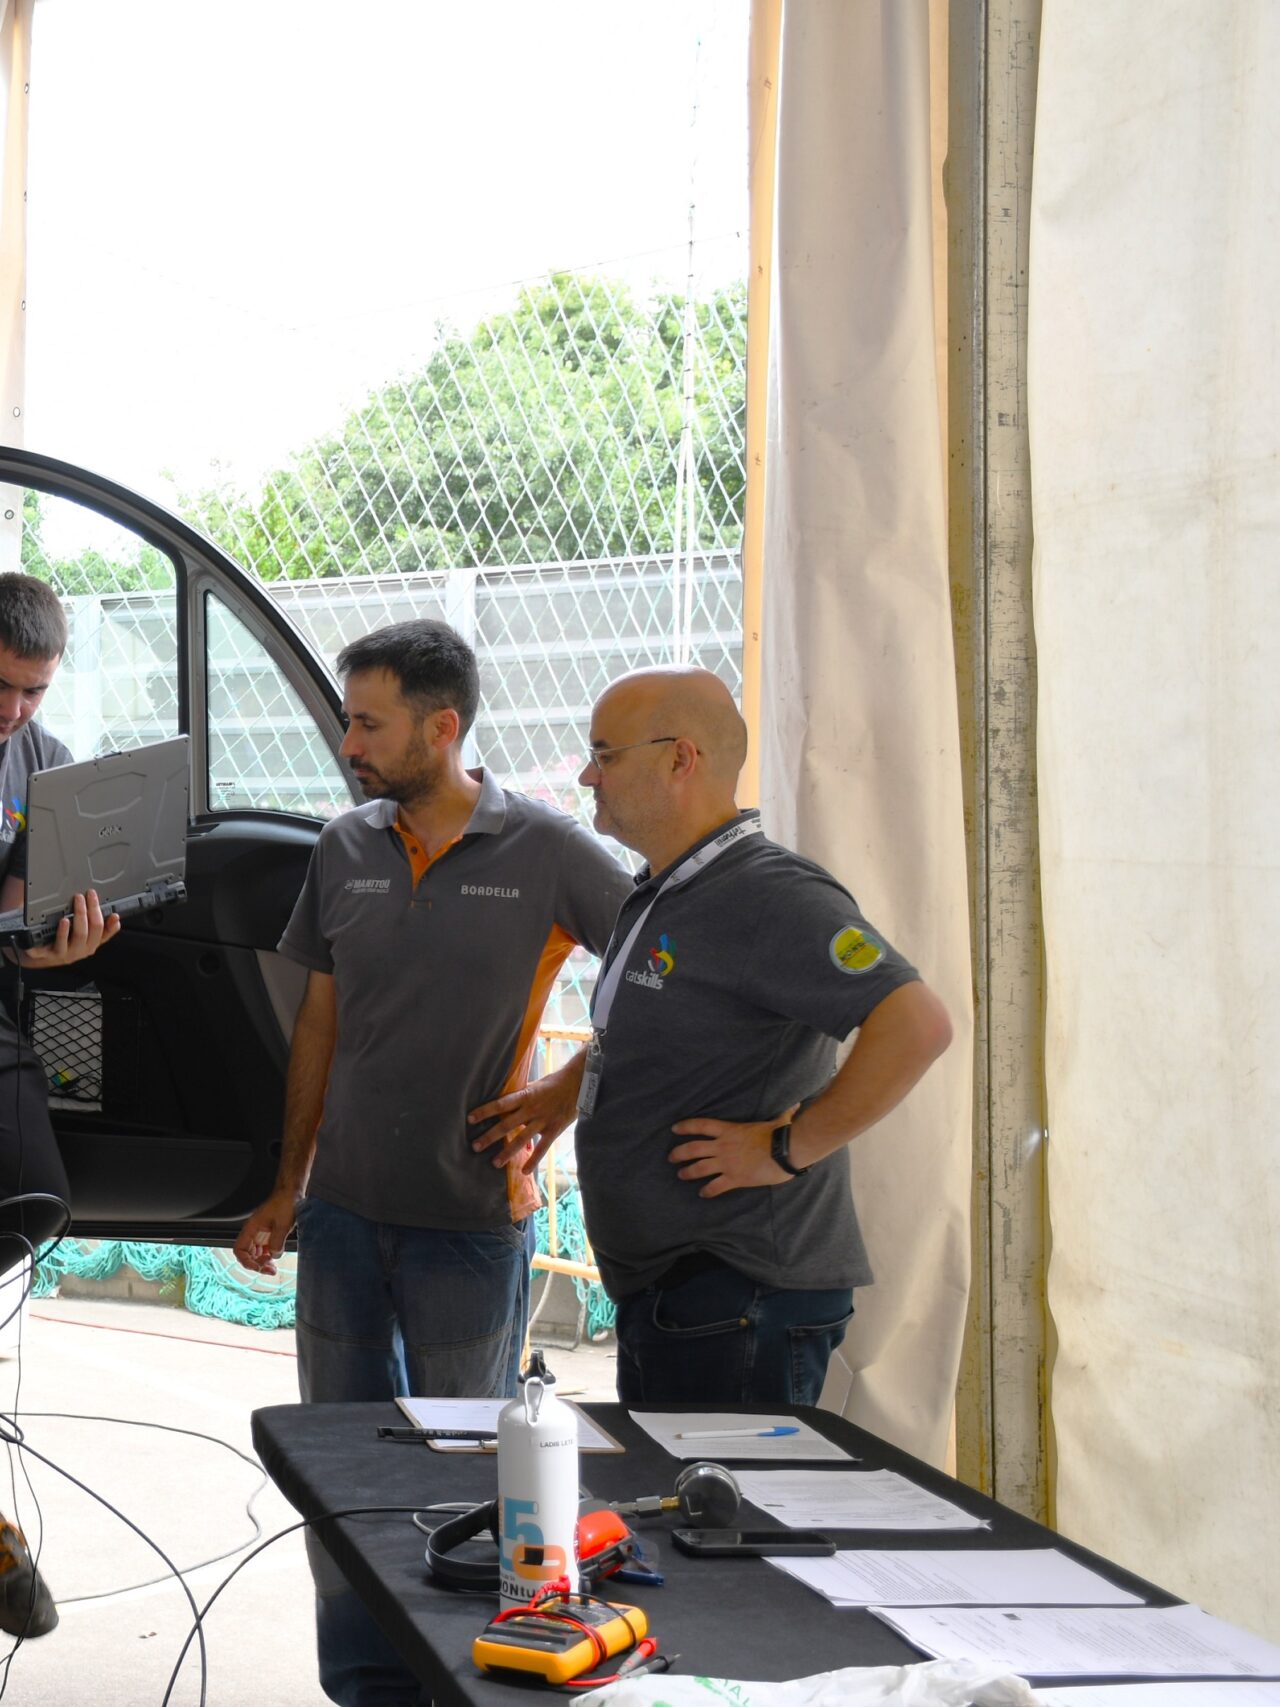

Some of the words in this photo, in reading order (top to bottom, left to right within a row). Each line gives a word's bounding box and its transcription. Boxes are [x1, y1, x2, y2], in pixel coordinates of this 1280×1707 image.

[353, 879, 391, 889] MANITOU
[460, 884, 520, 899] BOADELLA
[625, 970, 664, 990] catskills
